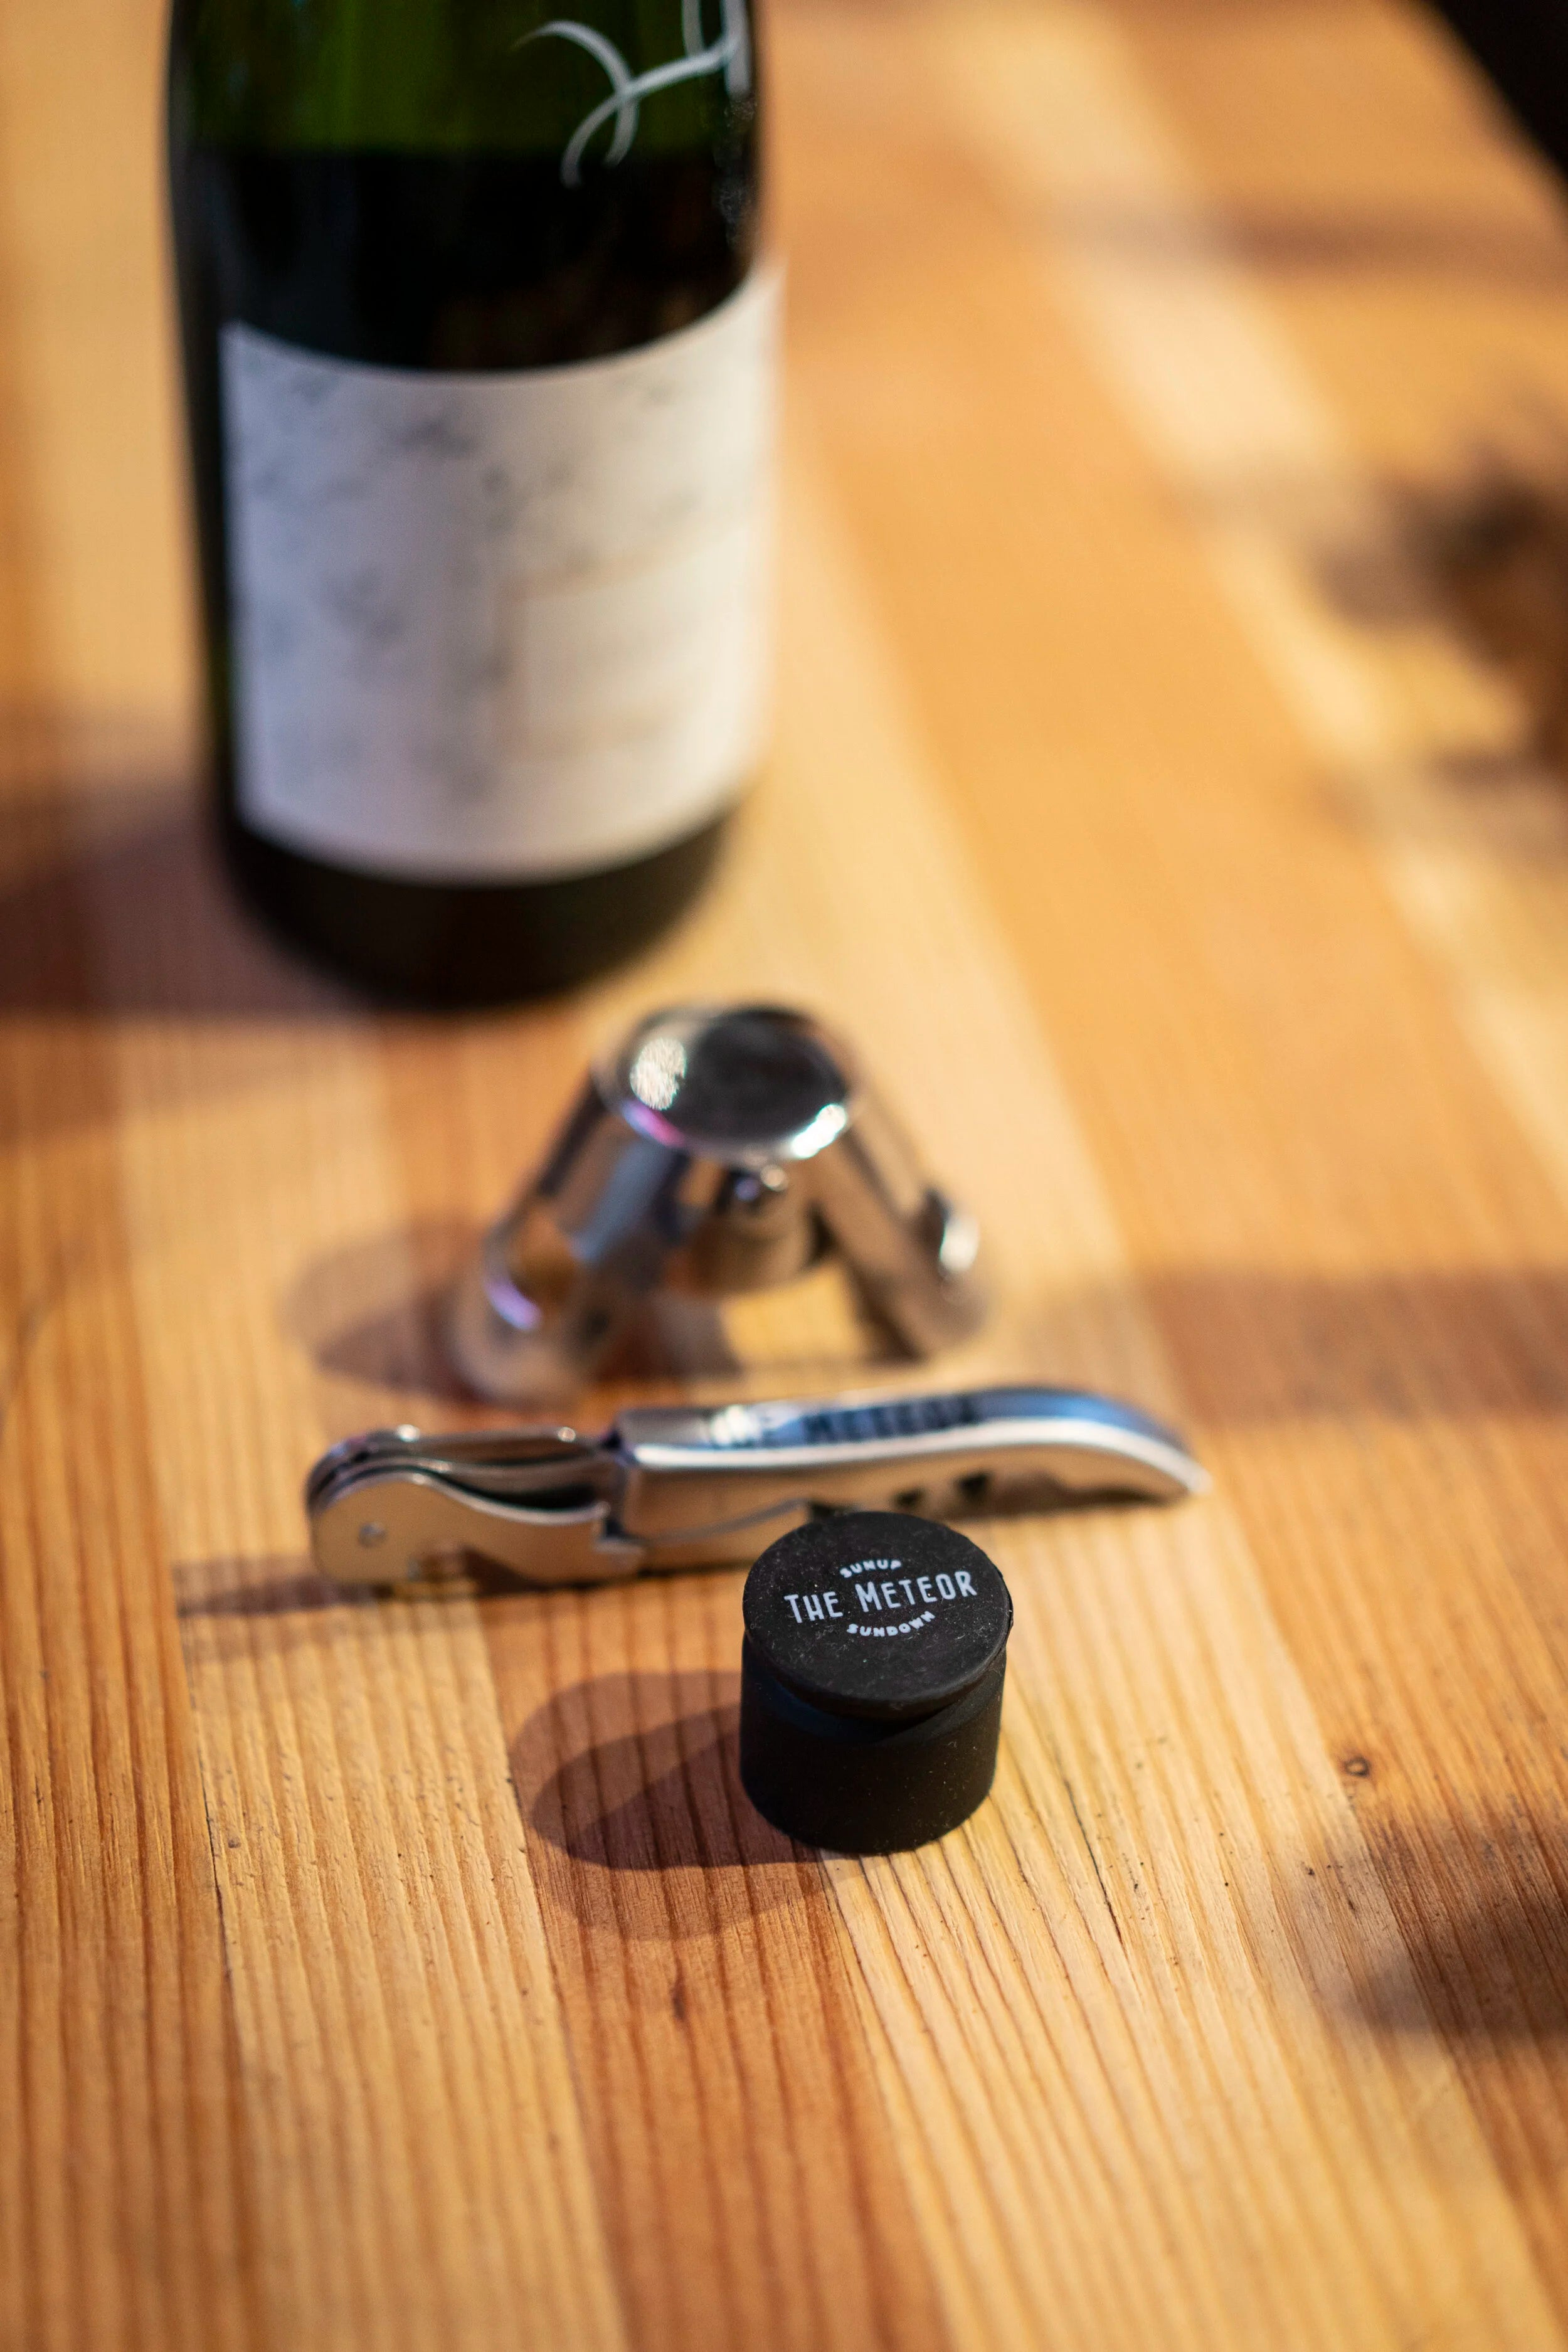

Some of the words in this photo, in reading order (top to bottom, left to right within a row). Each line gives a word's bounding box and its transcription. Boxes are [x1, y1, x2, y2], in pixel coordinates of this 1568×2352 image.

[840, 1559, 902, 1578] SUNUP
[784, 1591, 843, 1623] THE
[855, 1571, 977, 1613] METEOR
[847, 1611, 935, 1637] SUNDOWN
